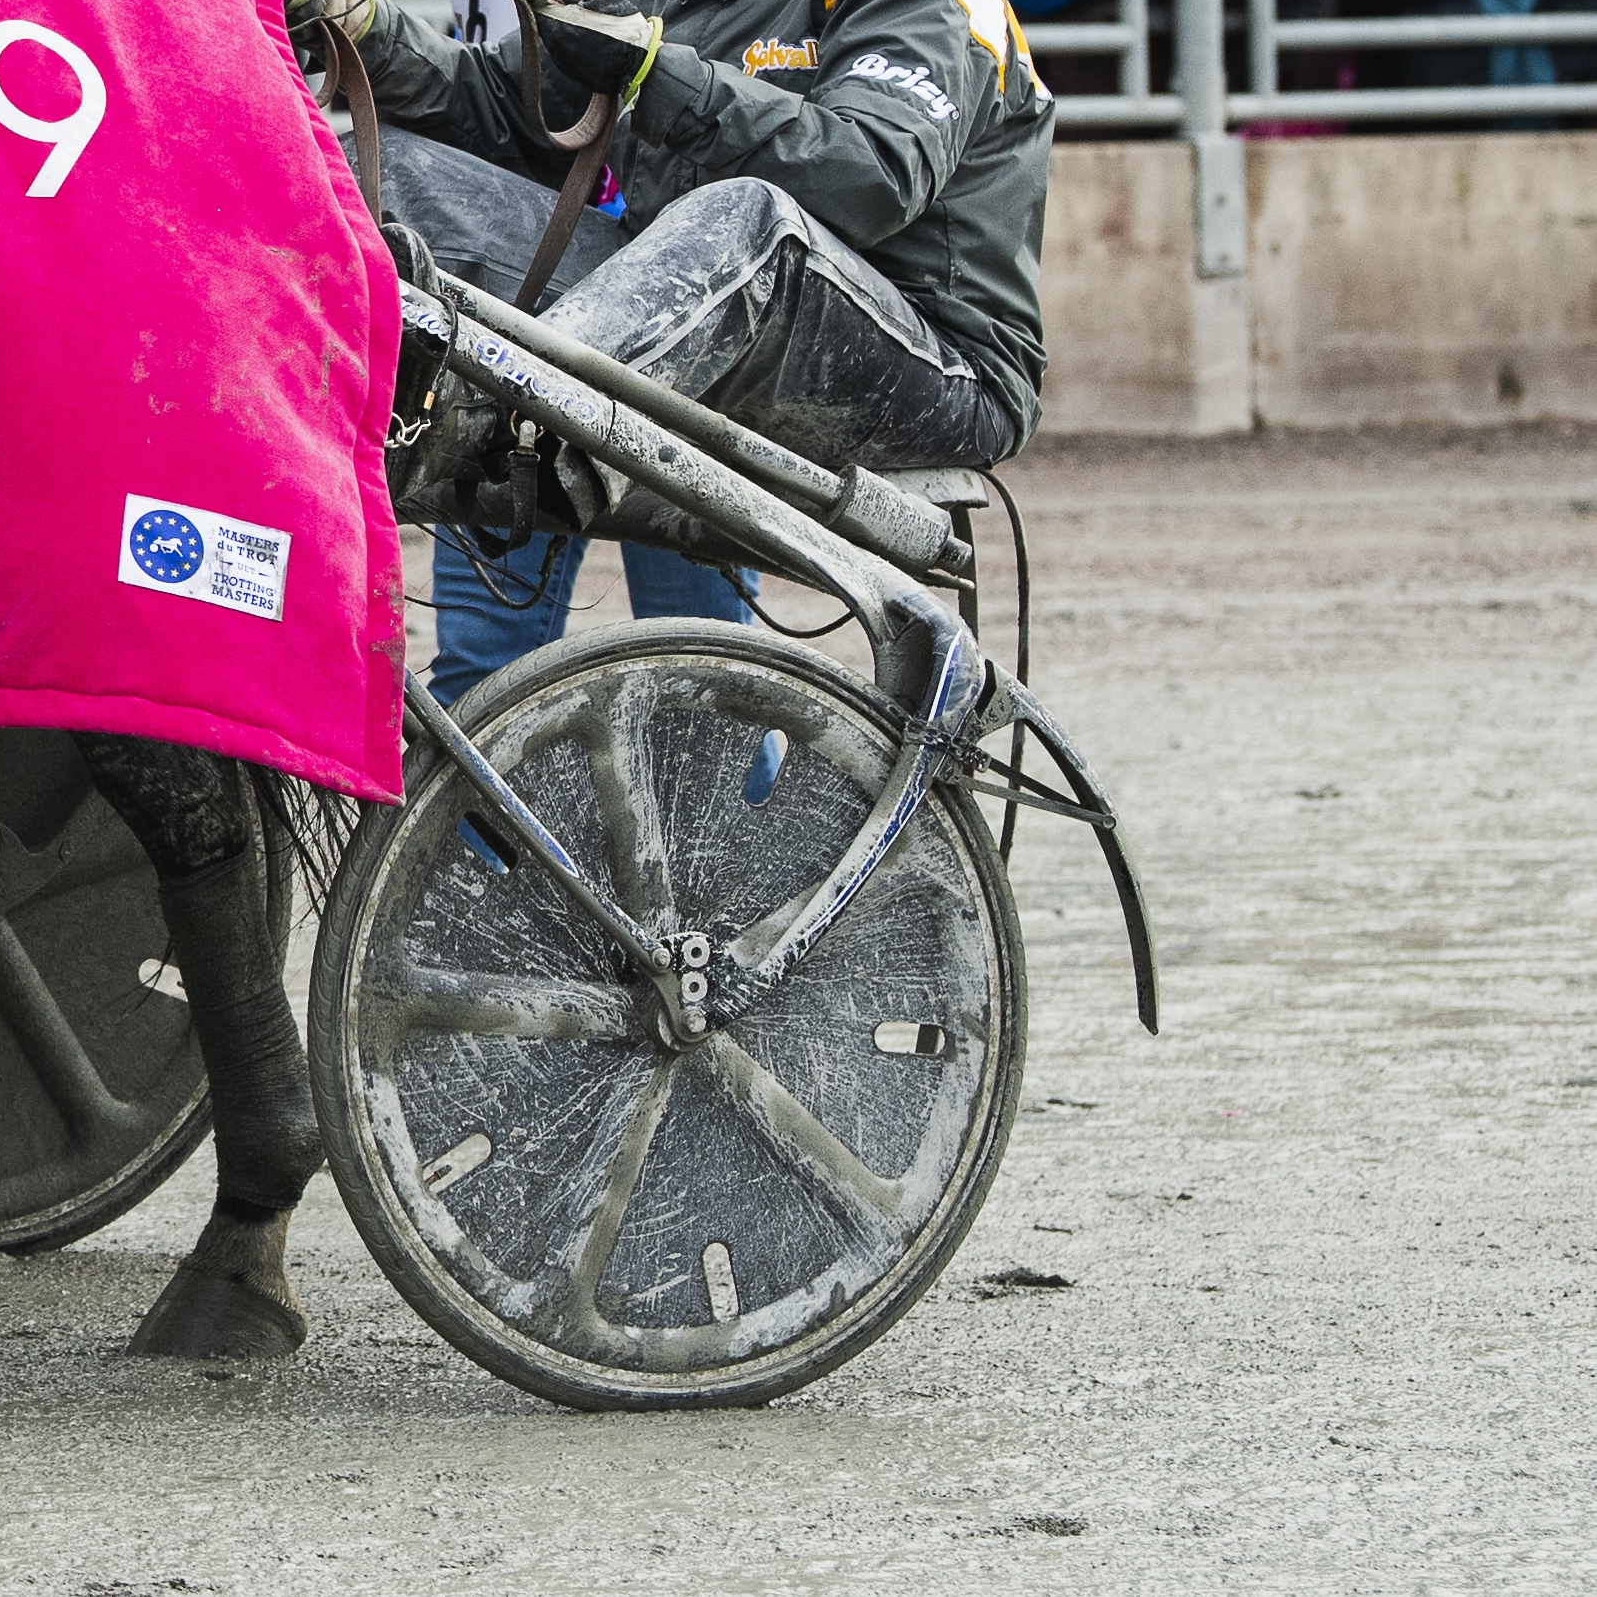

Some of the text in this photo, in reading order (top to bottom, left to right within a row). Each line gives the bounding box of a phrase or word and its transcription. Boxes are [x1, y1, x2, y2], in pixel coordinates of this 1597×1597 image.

[742, 38, 819, 78] Solvall
[217, 540, 278, 566] du TROT
[218, 526, 280, 553] MASTERS
[211, 584, 274, 611] MASTERS
[213, 572, 275, 597] TROTTING
